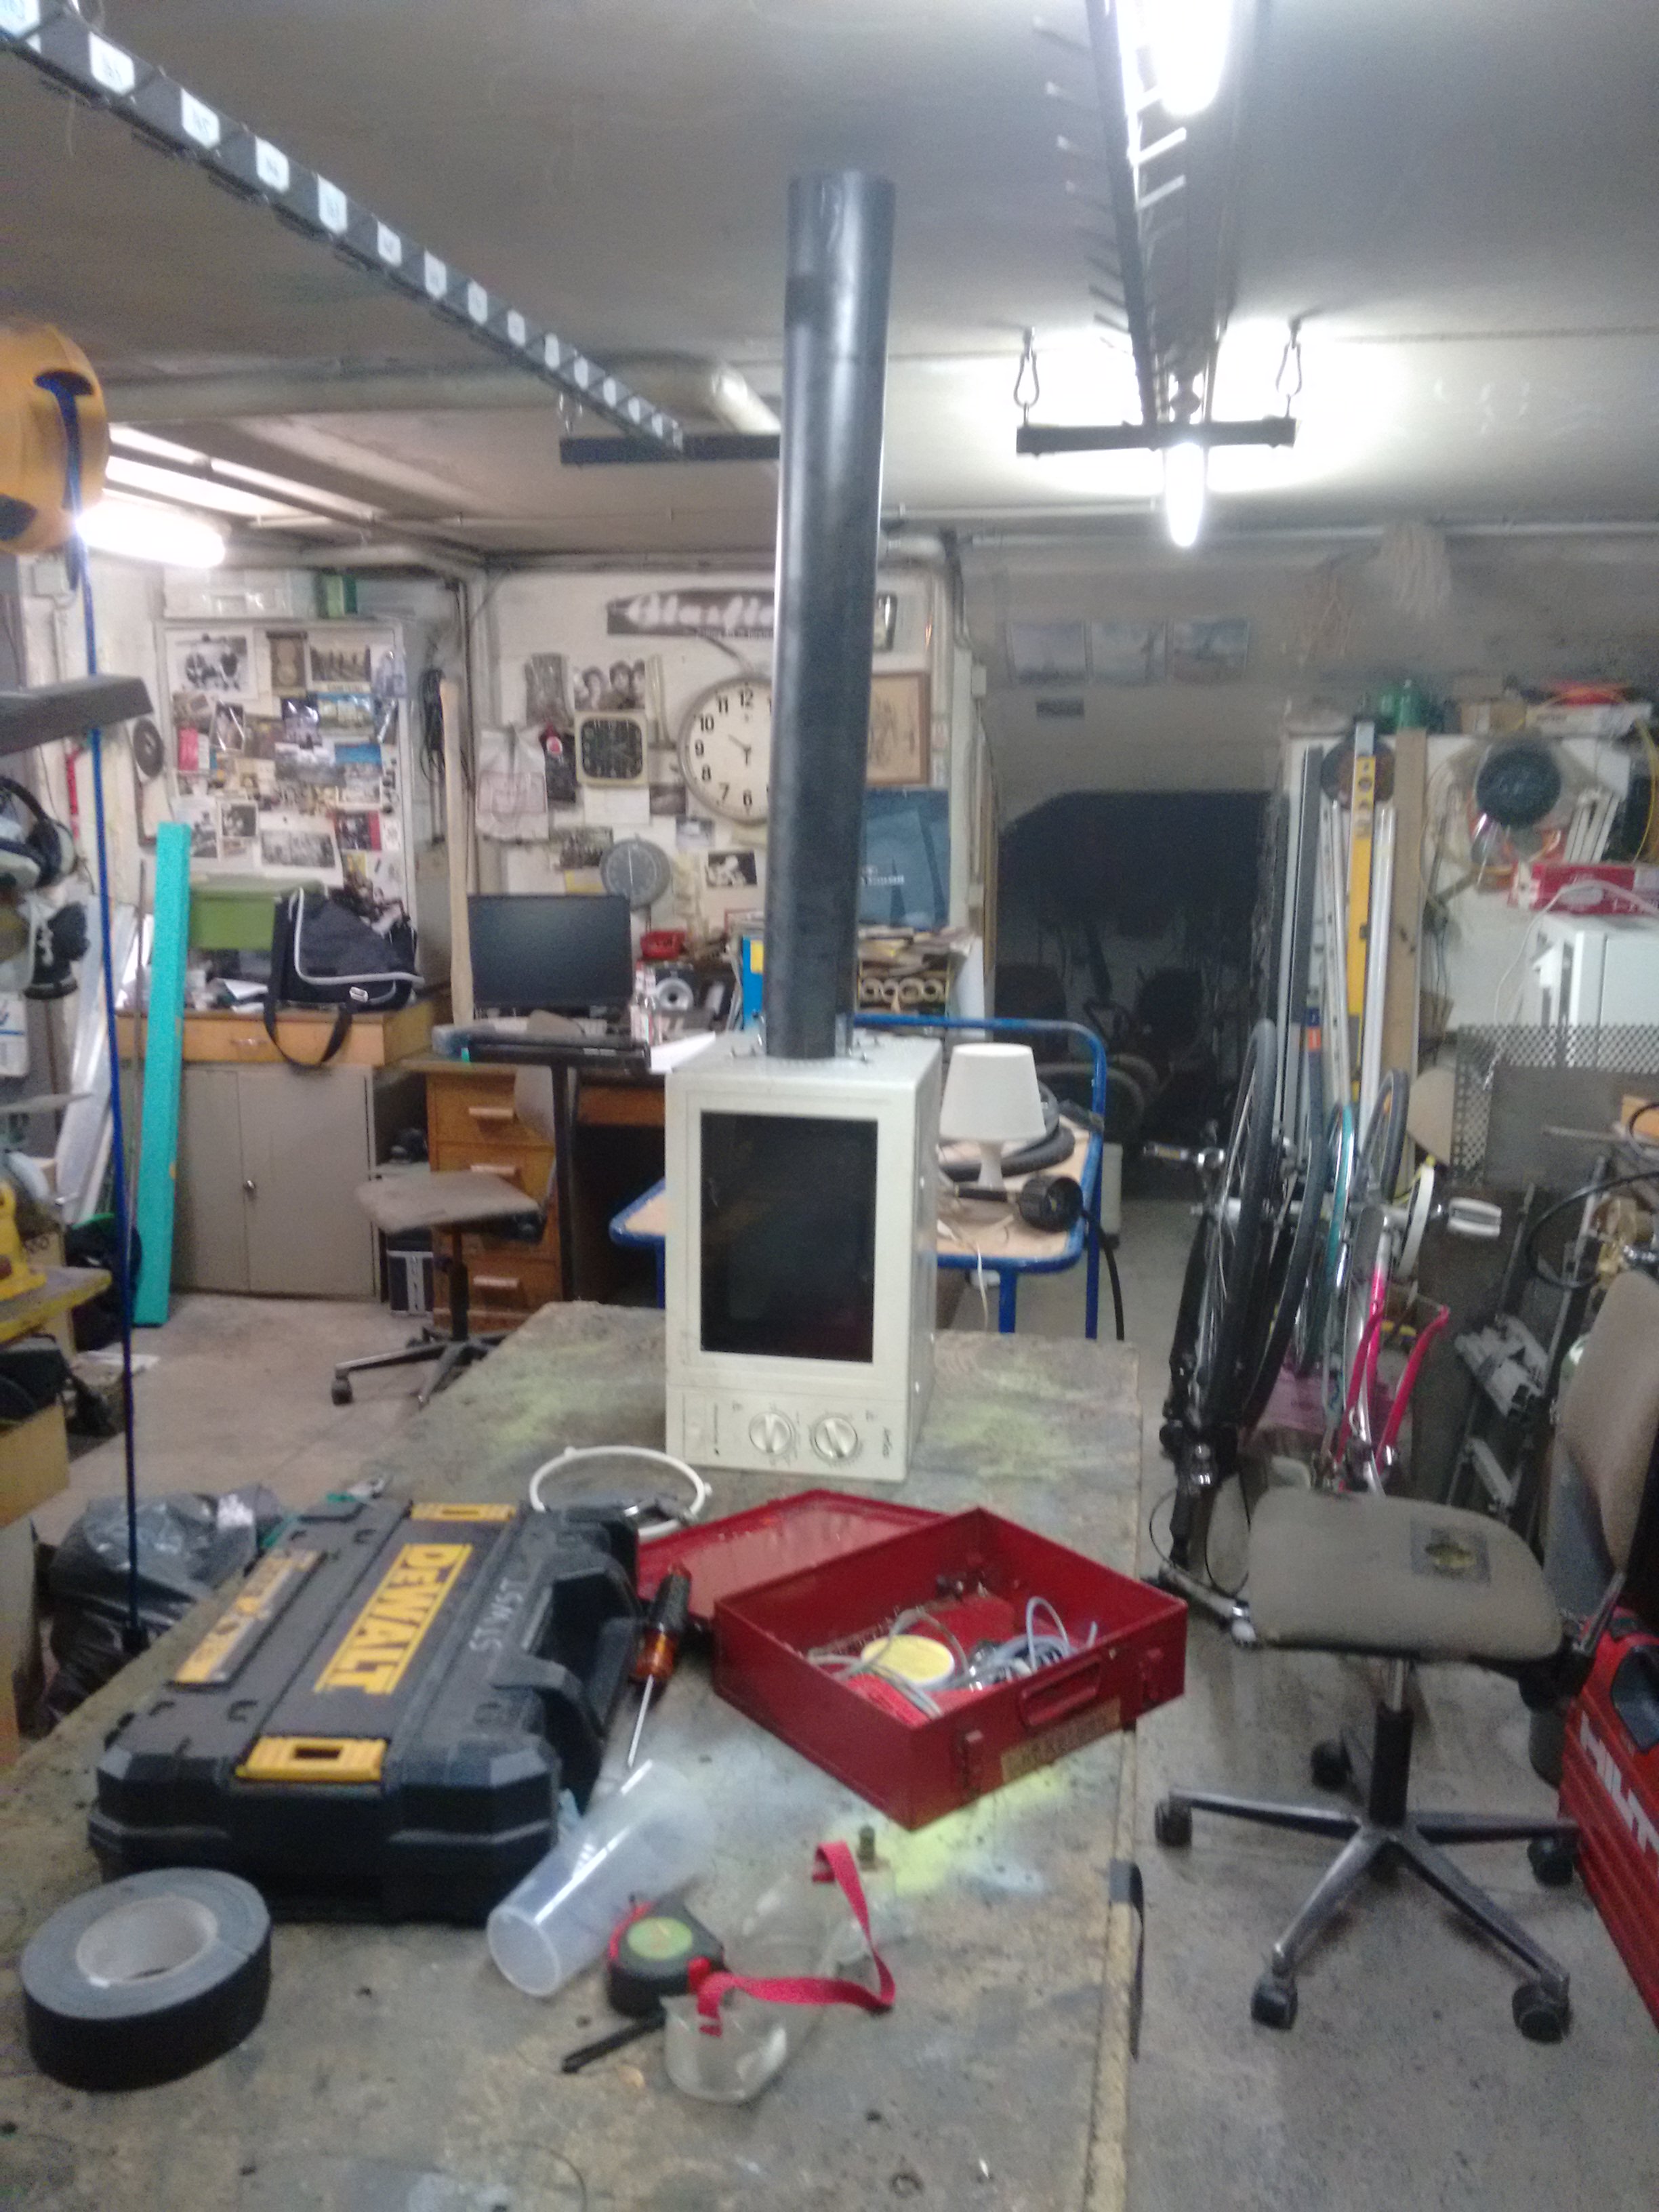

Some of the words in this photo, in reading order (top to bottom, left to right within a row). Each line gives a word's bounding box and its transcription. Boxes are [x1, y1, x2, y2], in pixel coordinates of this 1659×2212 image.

[718, 696, 729, 712] 11
[740, 689, 754, 707] 12
[700, 714, 714, 732] 10
[695, 739, 704, 756] 9
[702, 764, 712, 782] 8
[720, 782, 729, 800] 7
[743, 790, 752, 807] 6
[317, 1544, 469, 1694] DEWALT
[1580, 1710, 1659, 1864] HILT
